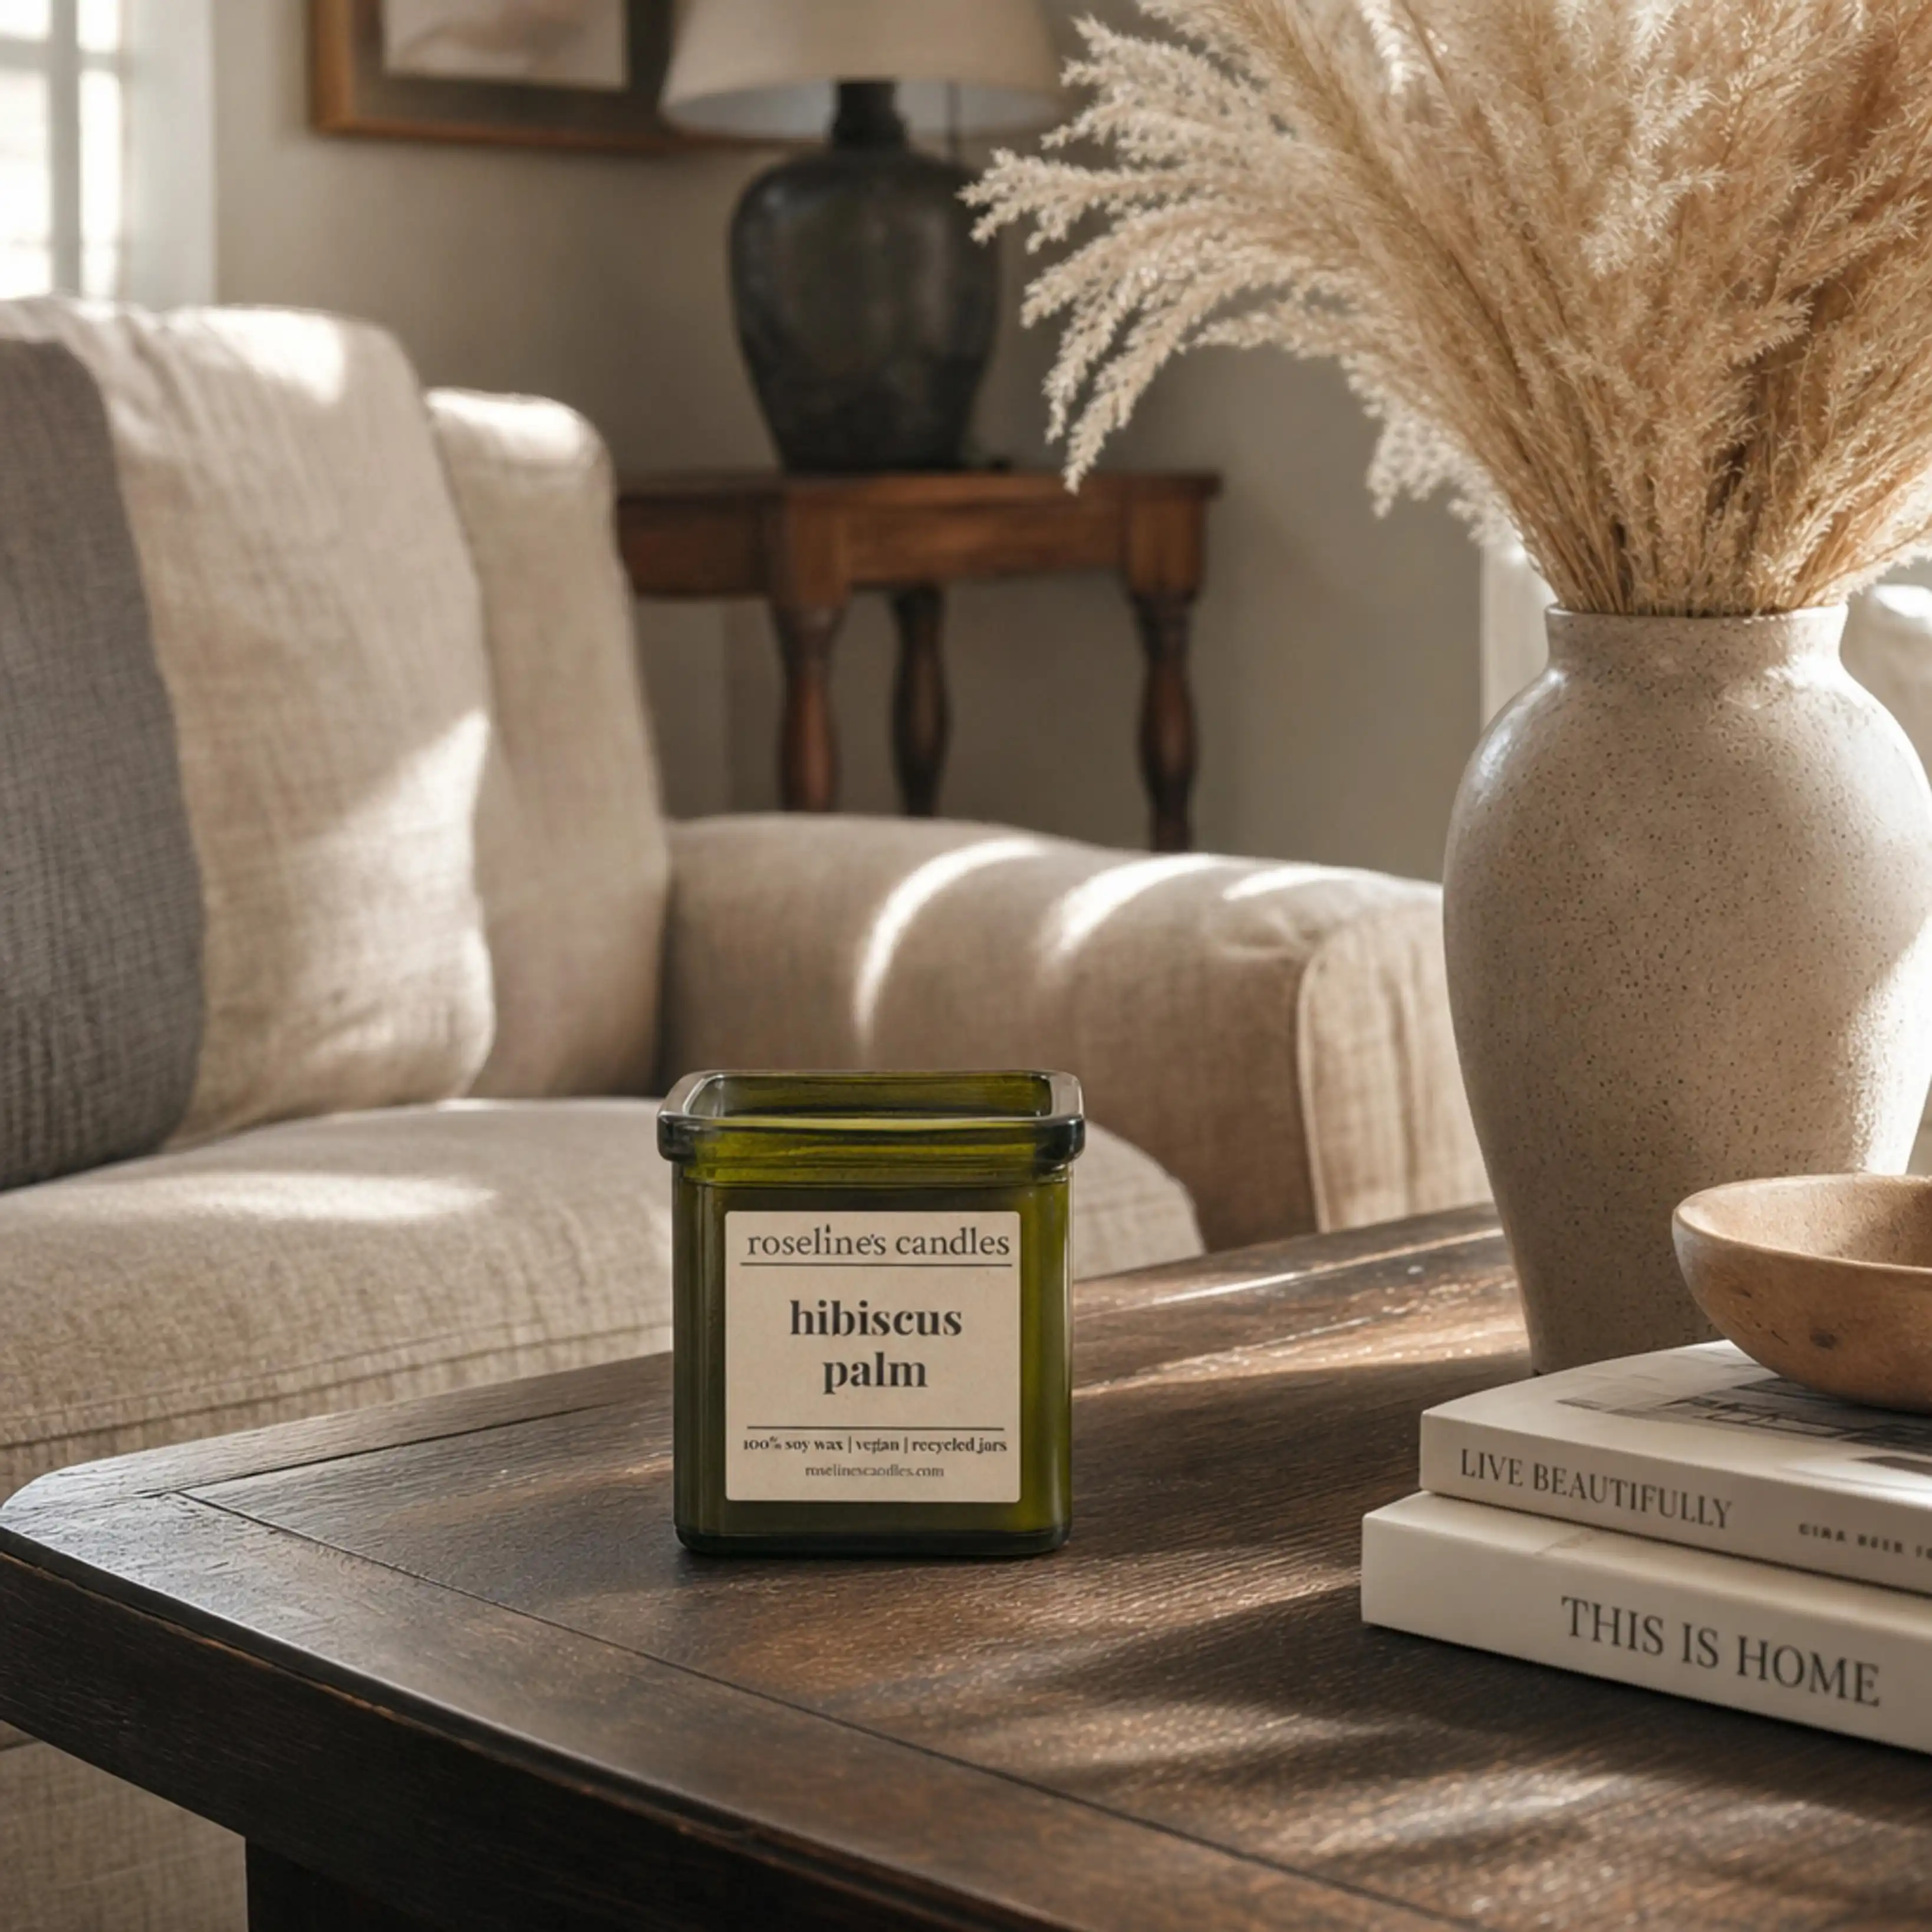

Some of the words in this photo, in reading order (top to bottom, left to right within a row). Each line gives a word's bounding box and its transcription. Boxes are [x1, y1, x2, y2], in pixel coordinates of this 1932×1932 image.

[747, 1224, 886, 1256] roseline's
[895, 1227, 1010, 1256] candles
[790, 1299, 962, 1337] hibiscus
[822, 1351, 928, 1395] palm
[743, 1436, 782, 1451] 100%
[785, 1440, 810, 1453] soy
[814, 1440, 844, 1452] wax
[855, 1437, 900, 1454] vegan
[911, 1437, 975, 1454] recycled
[976, 1437, 1008, 1454] jars
[1461, 1448, 1523, 1487] LIVE
[1533, 1463, 1733, 1529] BEAUTIFULLY
[1561, 1595, 1664, 1655] THIS
[1681, 1623, 1719, 1669] IS
[1736, 1635, 1880, 1707] HOME
